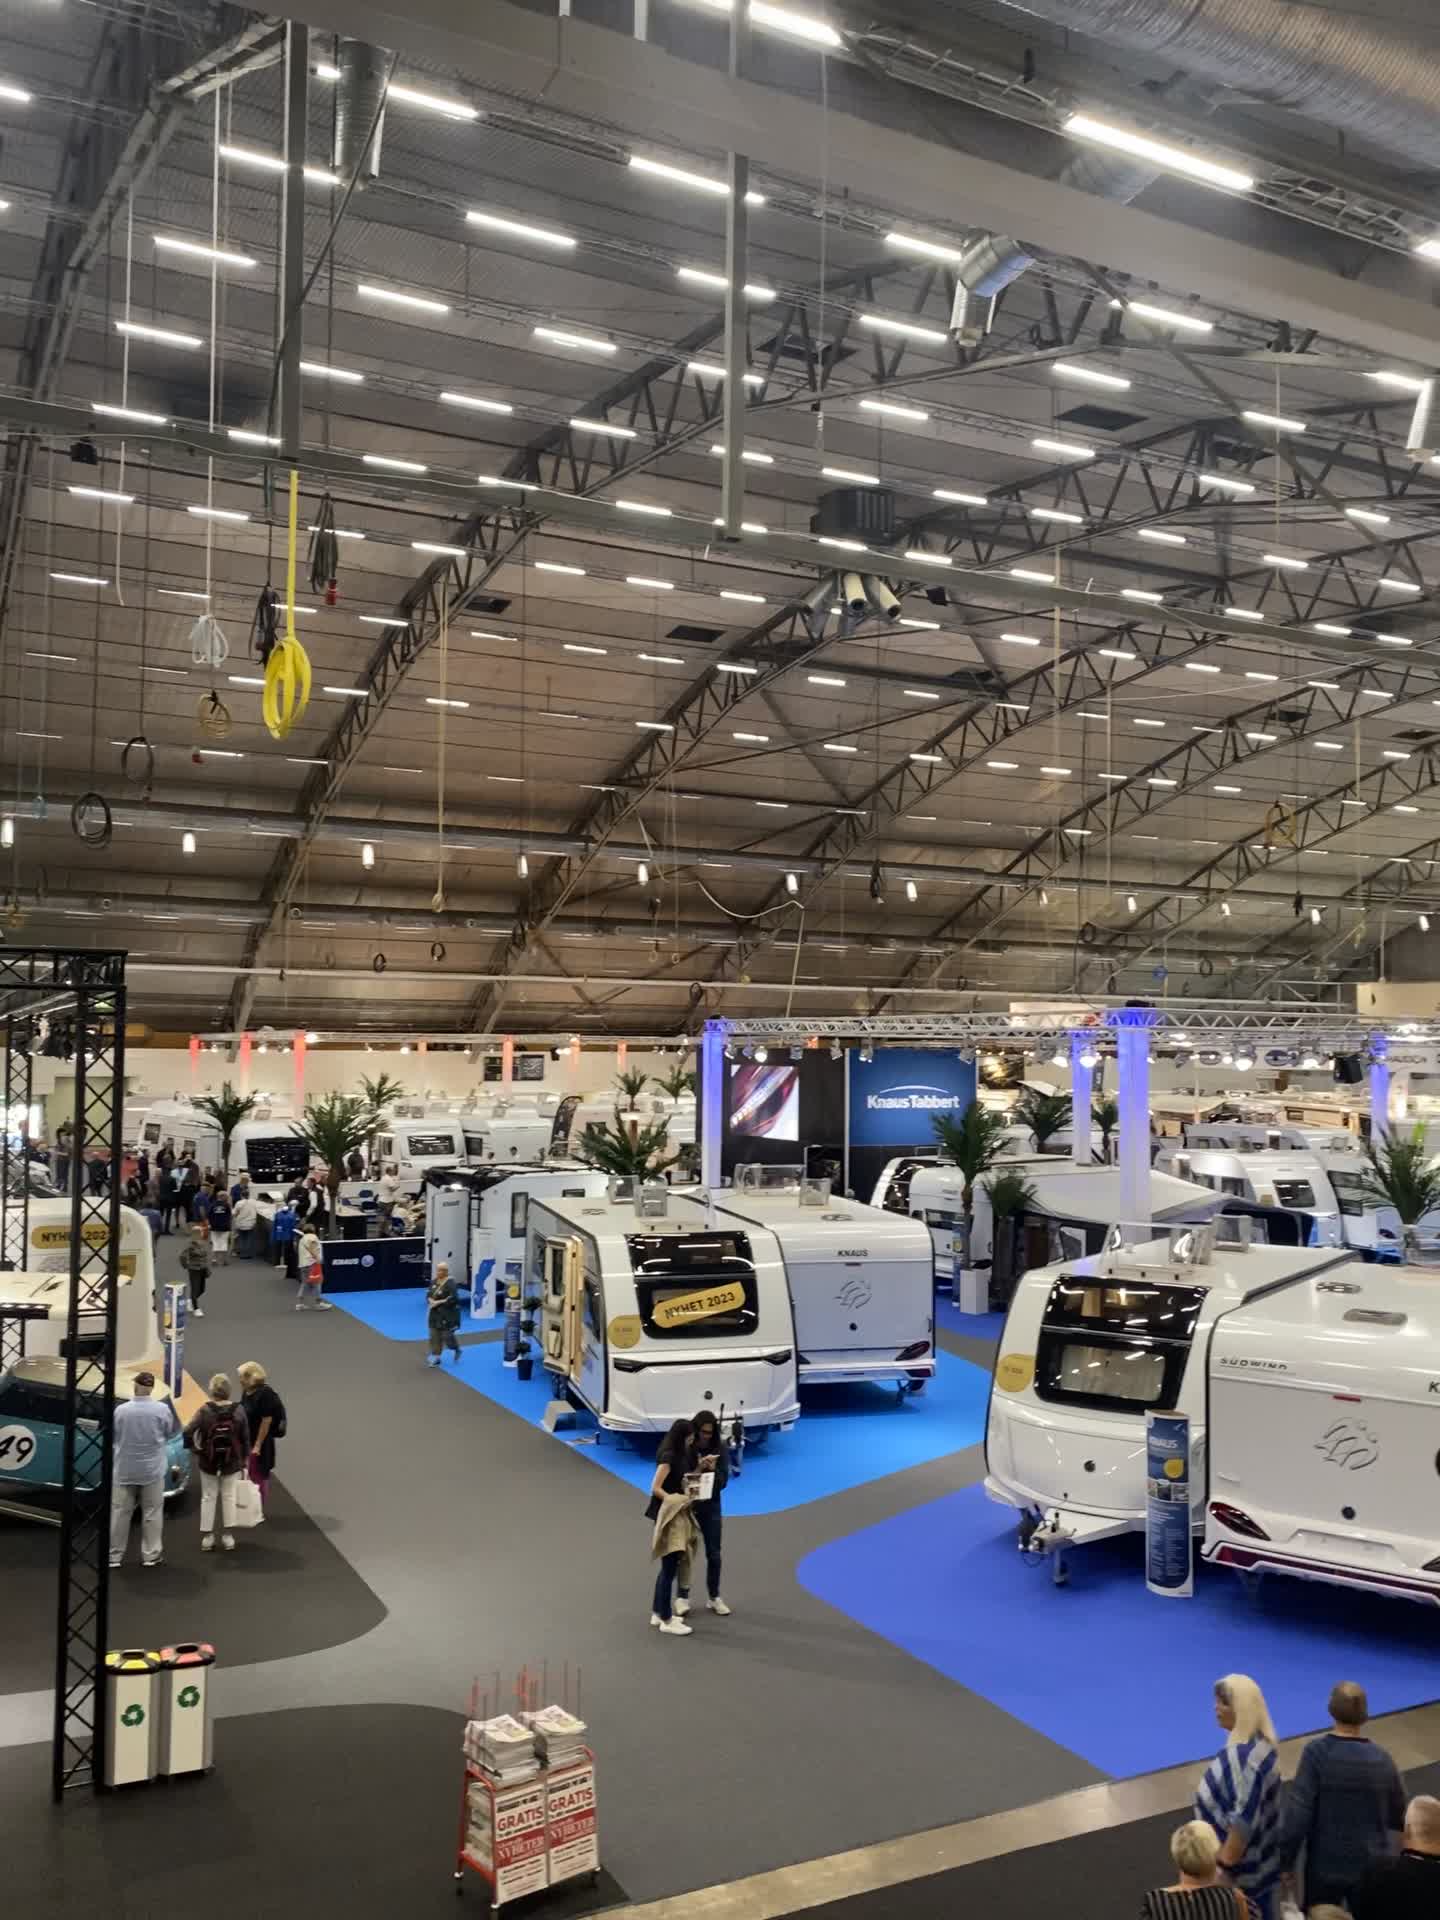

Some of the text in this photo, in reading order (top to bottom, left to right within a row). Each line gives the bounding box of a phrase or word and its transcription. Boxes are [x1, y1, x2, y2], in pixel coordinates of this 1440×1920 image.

[86, 1230, 107, 1241] 202
[838, 1249, 868, 1257] KNAUS
[664, 1291, 736, 1320] NYHET 2023
[0, 1435, 33, 1463] 49
[550, 1786, 593, 1812] GRATIS
[497, 1806, 544, 1832] GRATIS
